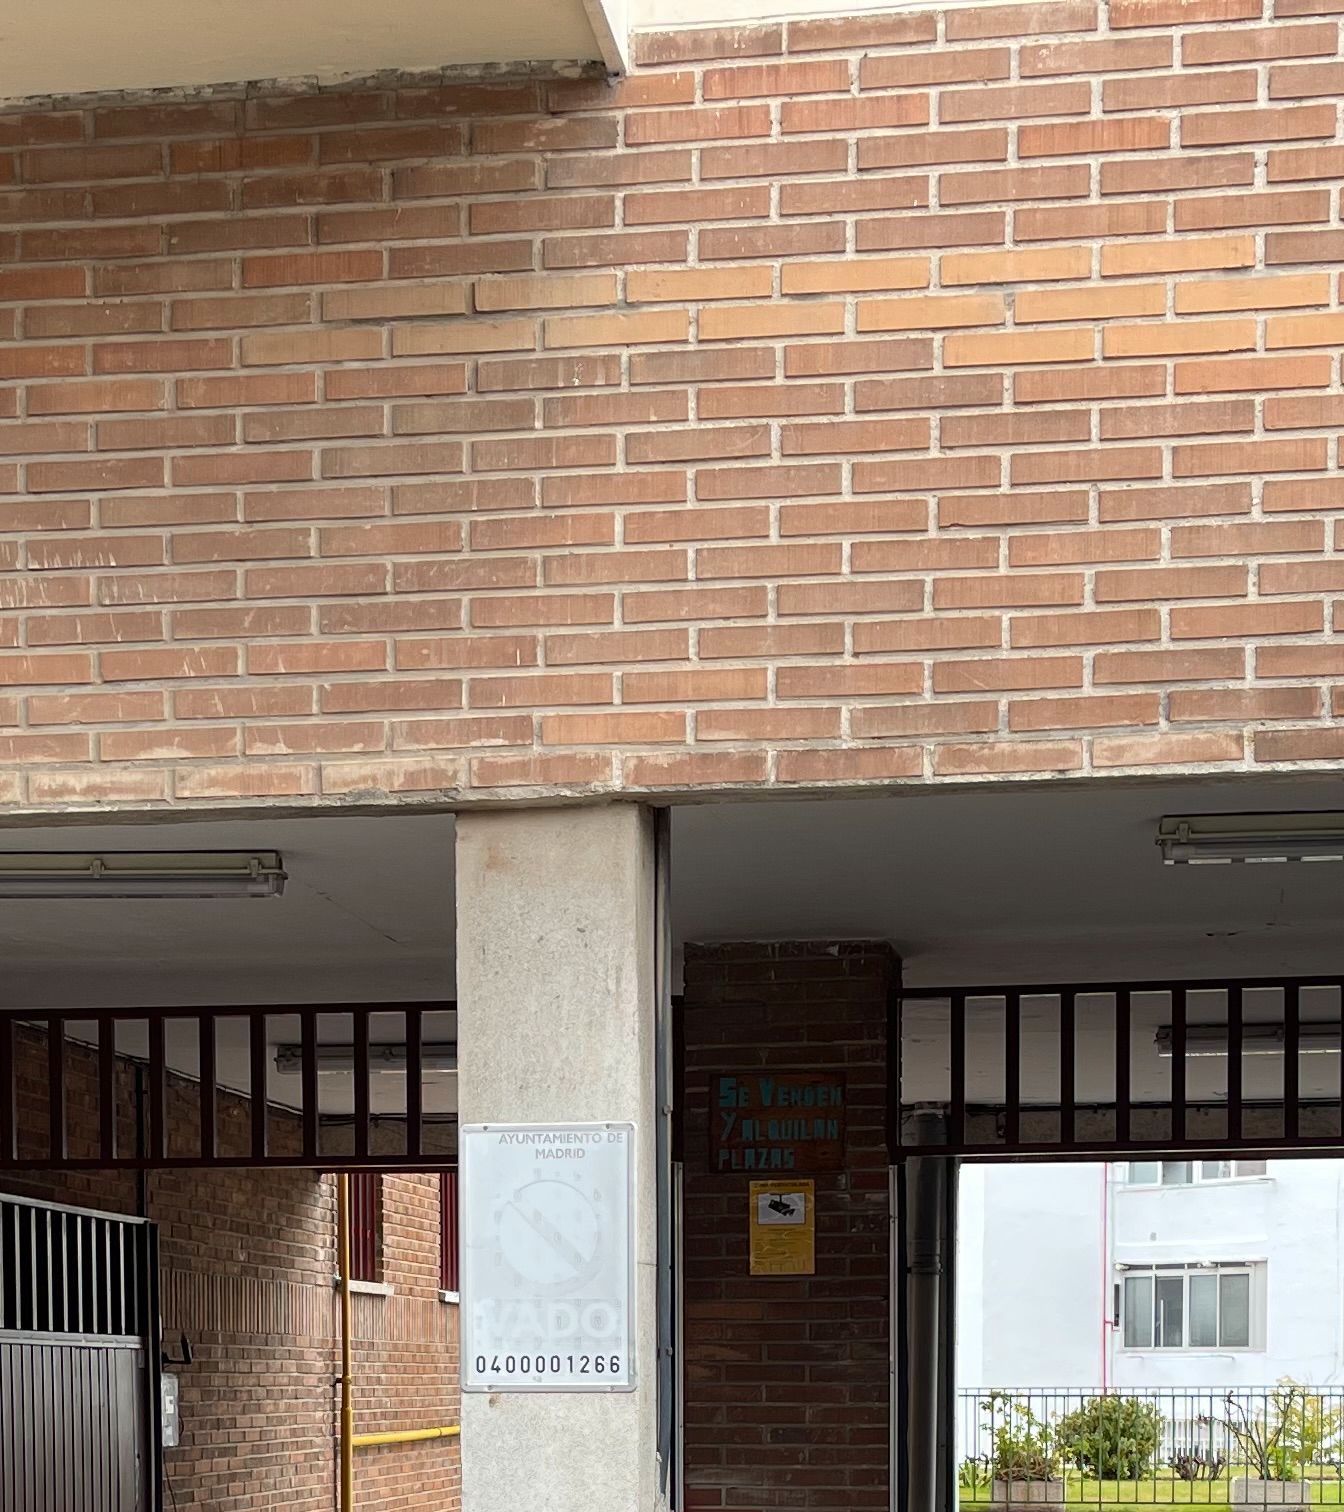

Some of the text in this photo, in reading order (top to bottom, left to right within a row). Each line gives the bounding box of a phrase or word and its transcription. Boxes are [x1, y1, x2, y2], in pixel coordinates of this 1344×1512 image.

[720, 1111, 737, 1142] Y
[498, 1132, 623, 1145] AYUNTAMIENTO DE
[535, 1147, 586, 1160] MADRID
[476, 1355, 621, 1374] 0400001266
